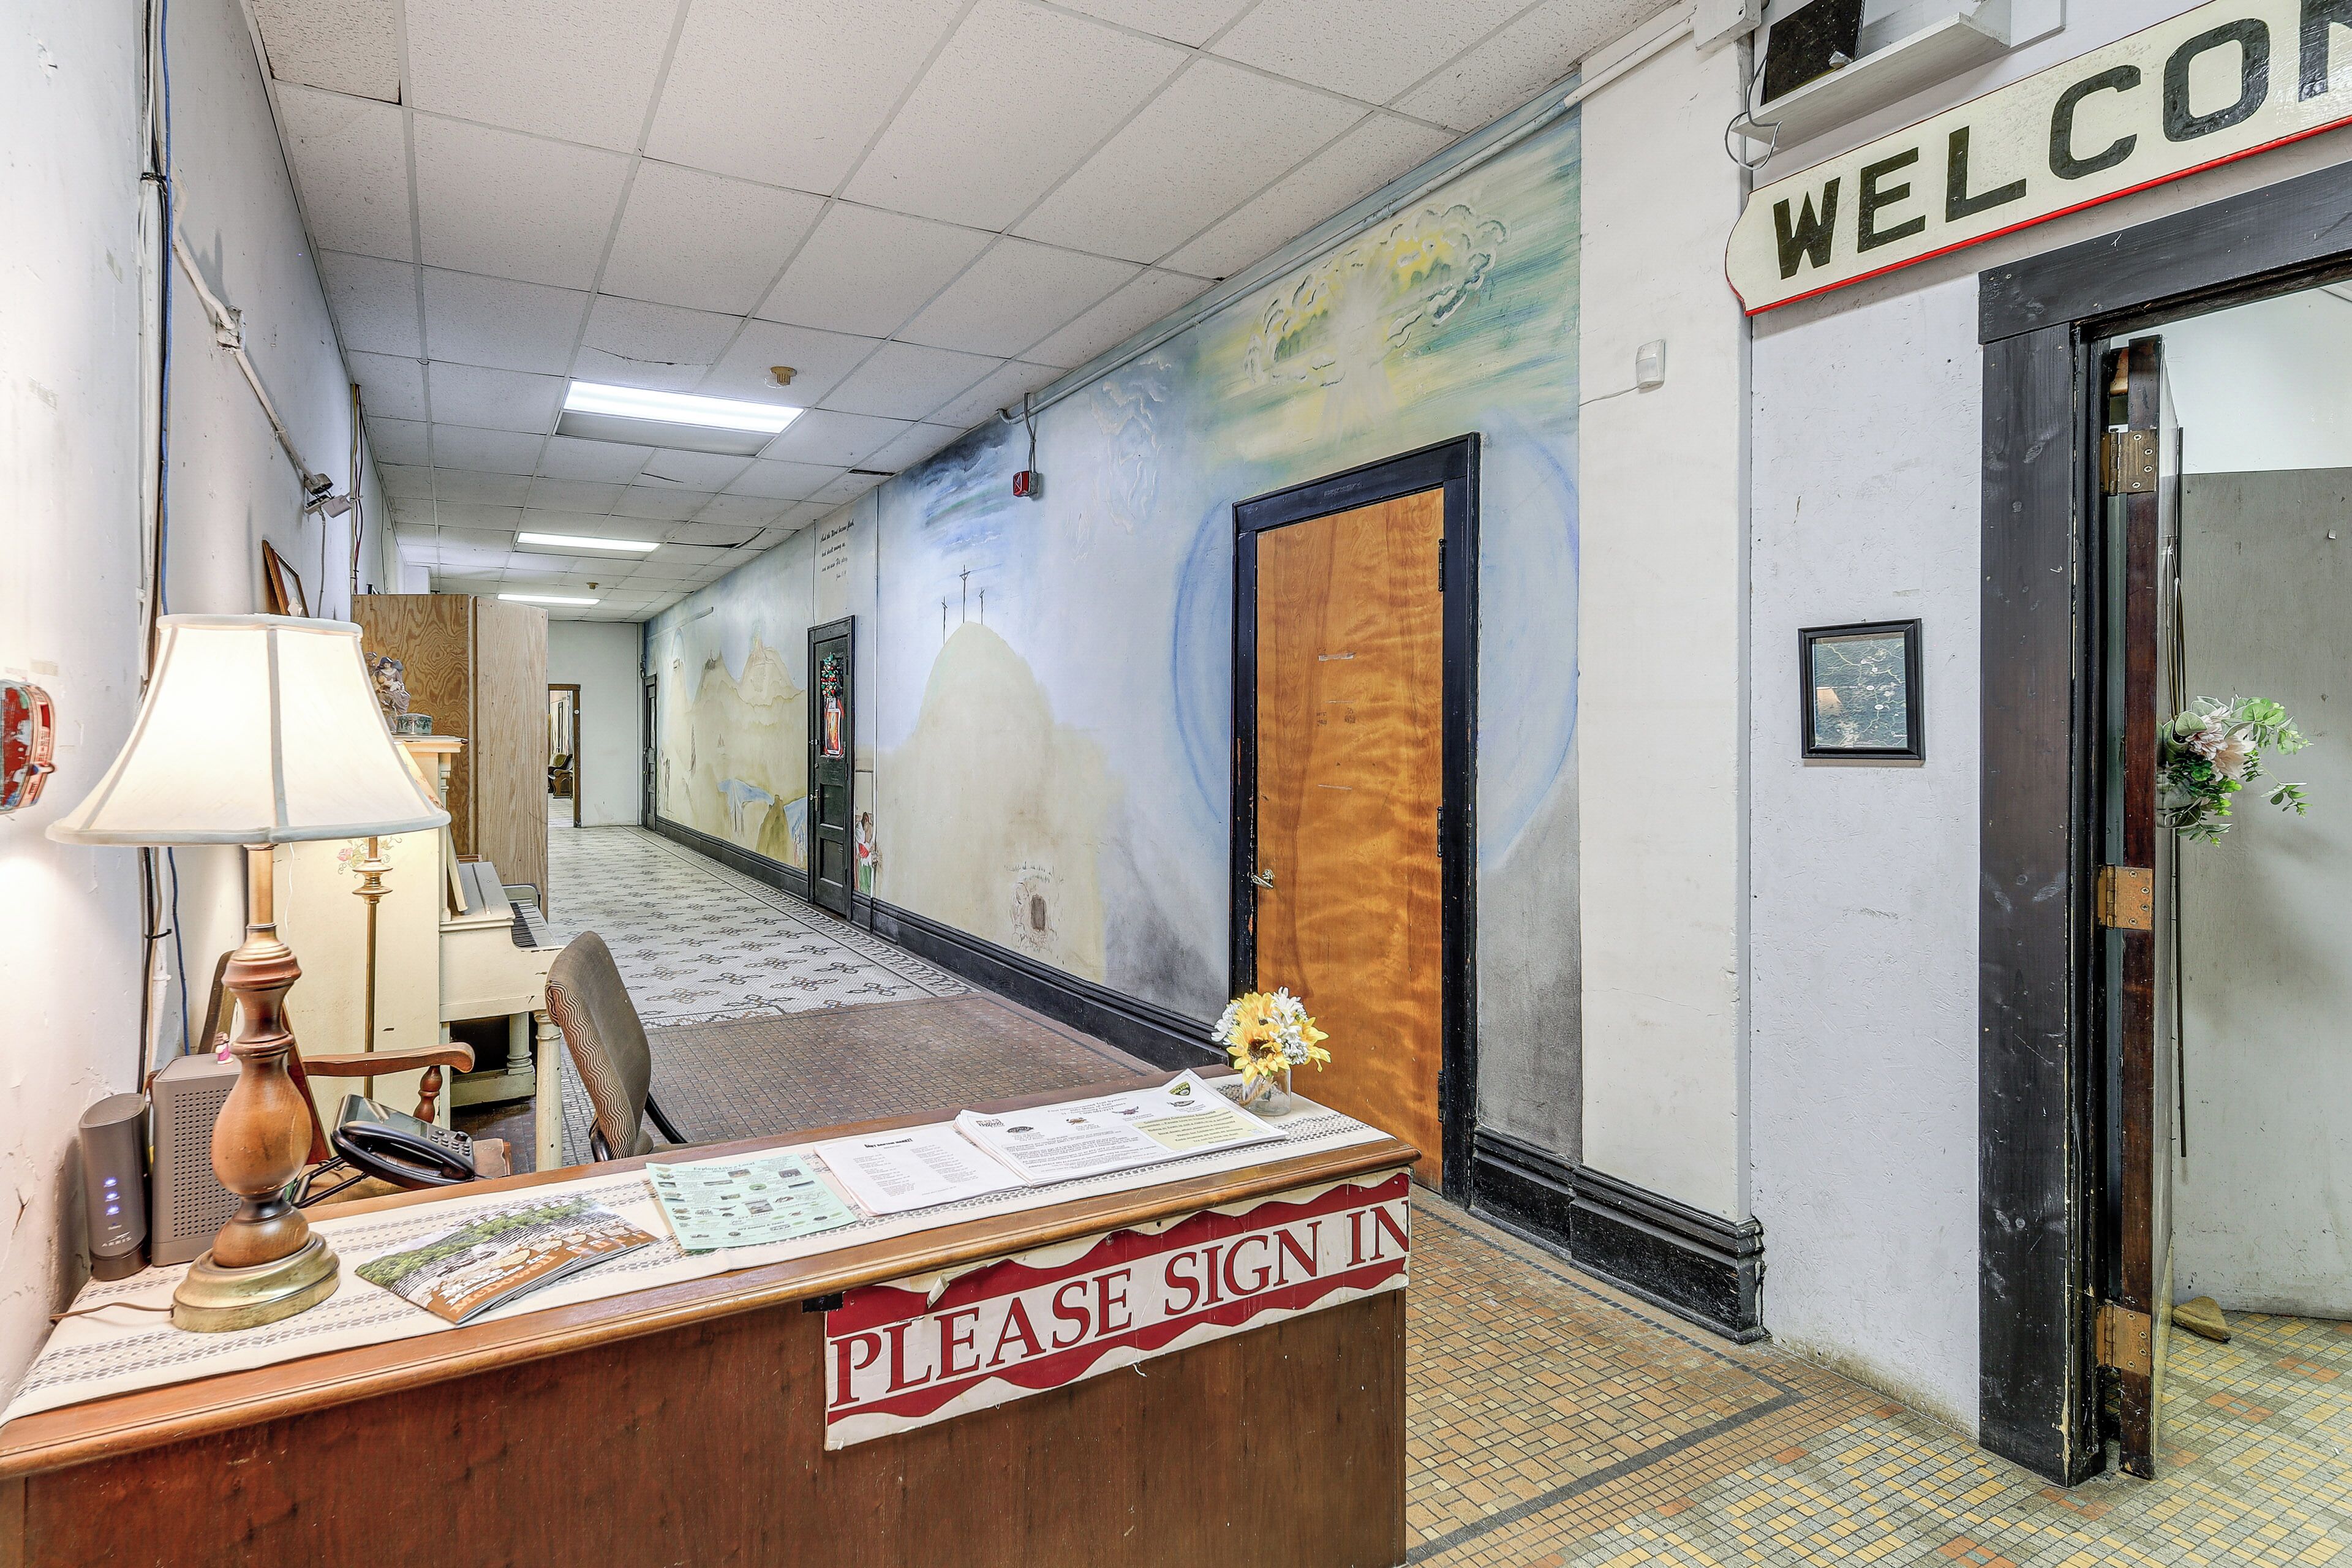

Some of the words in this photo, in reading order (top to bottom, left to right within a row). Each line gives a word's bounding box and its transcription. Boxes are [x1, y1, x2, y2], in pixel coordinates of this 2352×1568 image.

[102, 1236, 132, 1248] ARRIS
[448, 1254, 558, 1314] McDowell
[830, 1268, 1133, 1407] PLEASE
[1164, 1219, 1322, 1316] SIGN
[1346, 1199, 1409, 1267] IN
